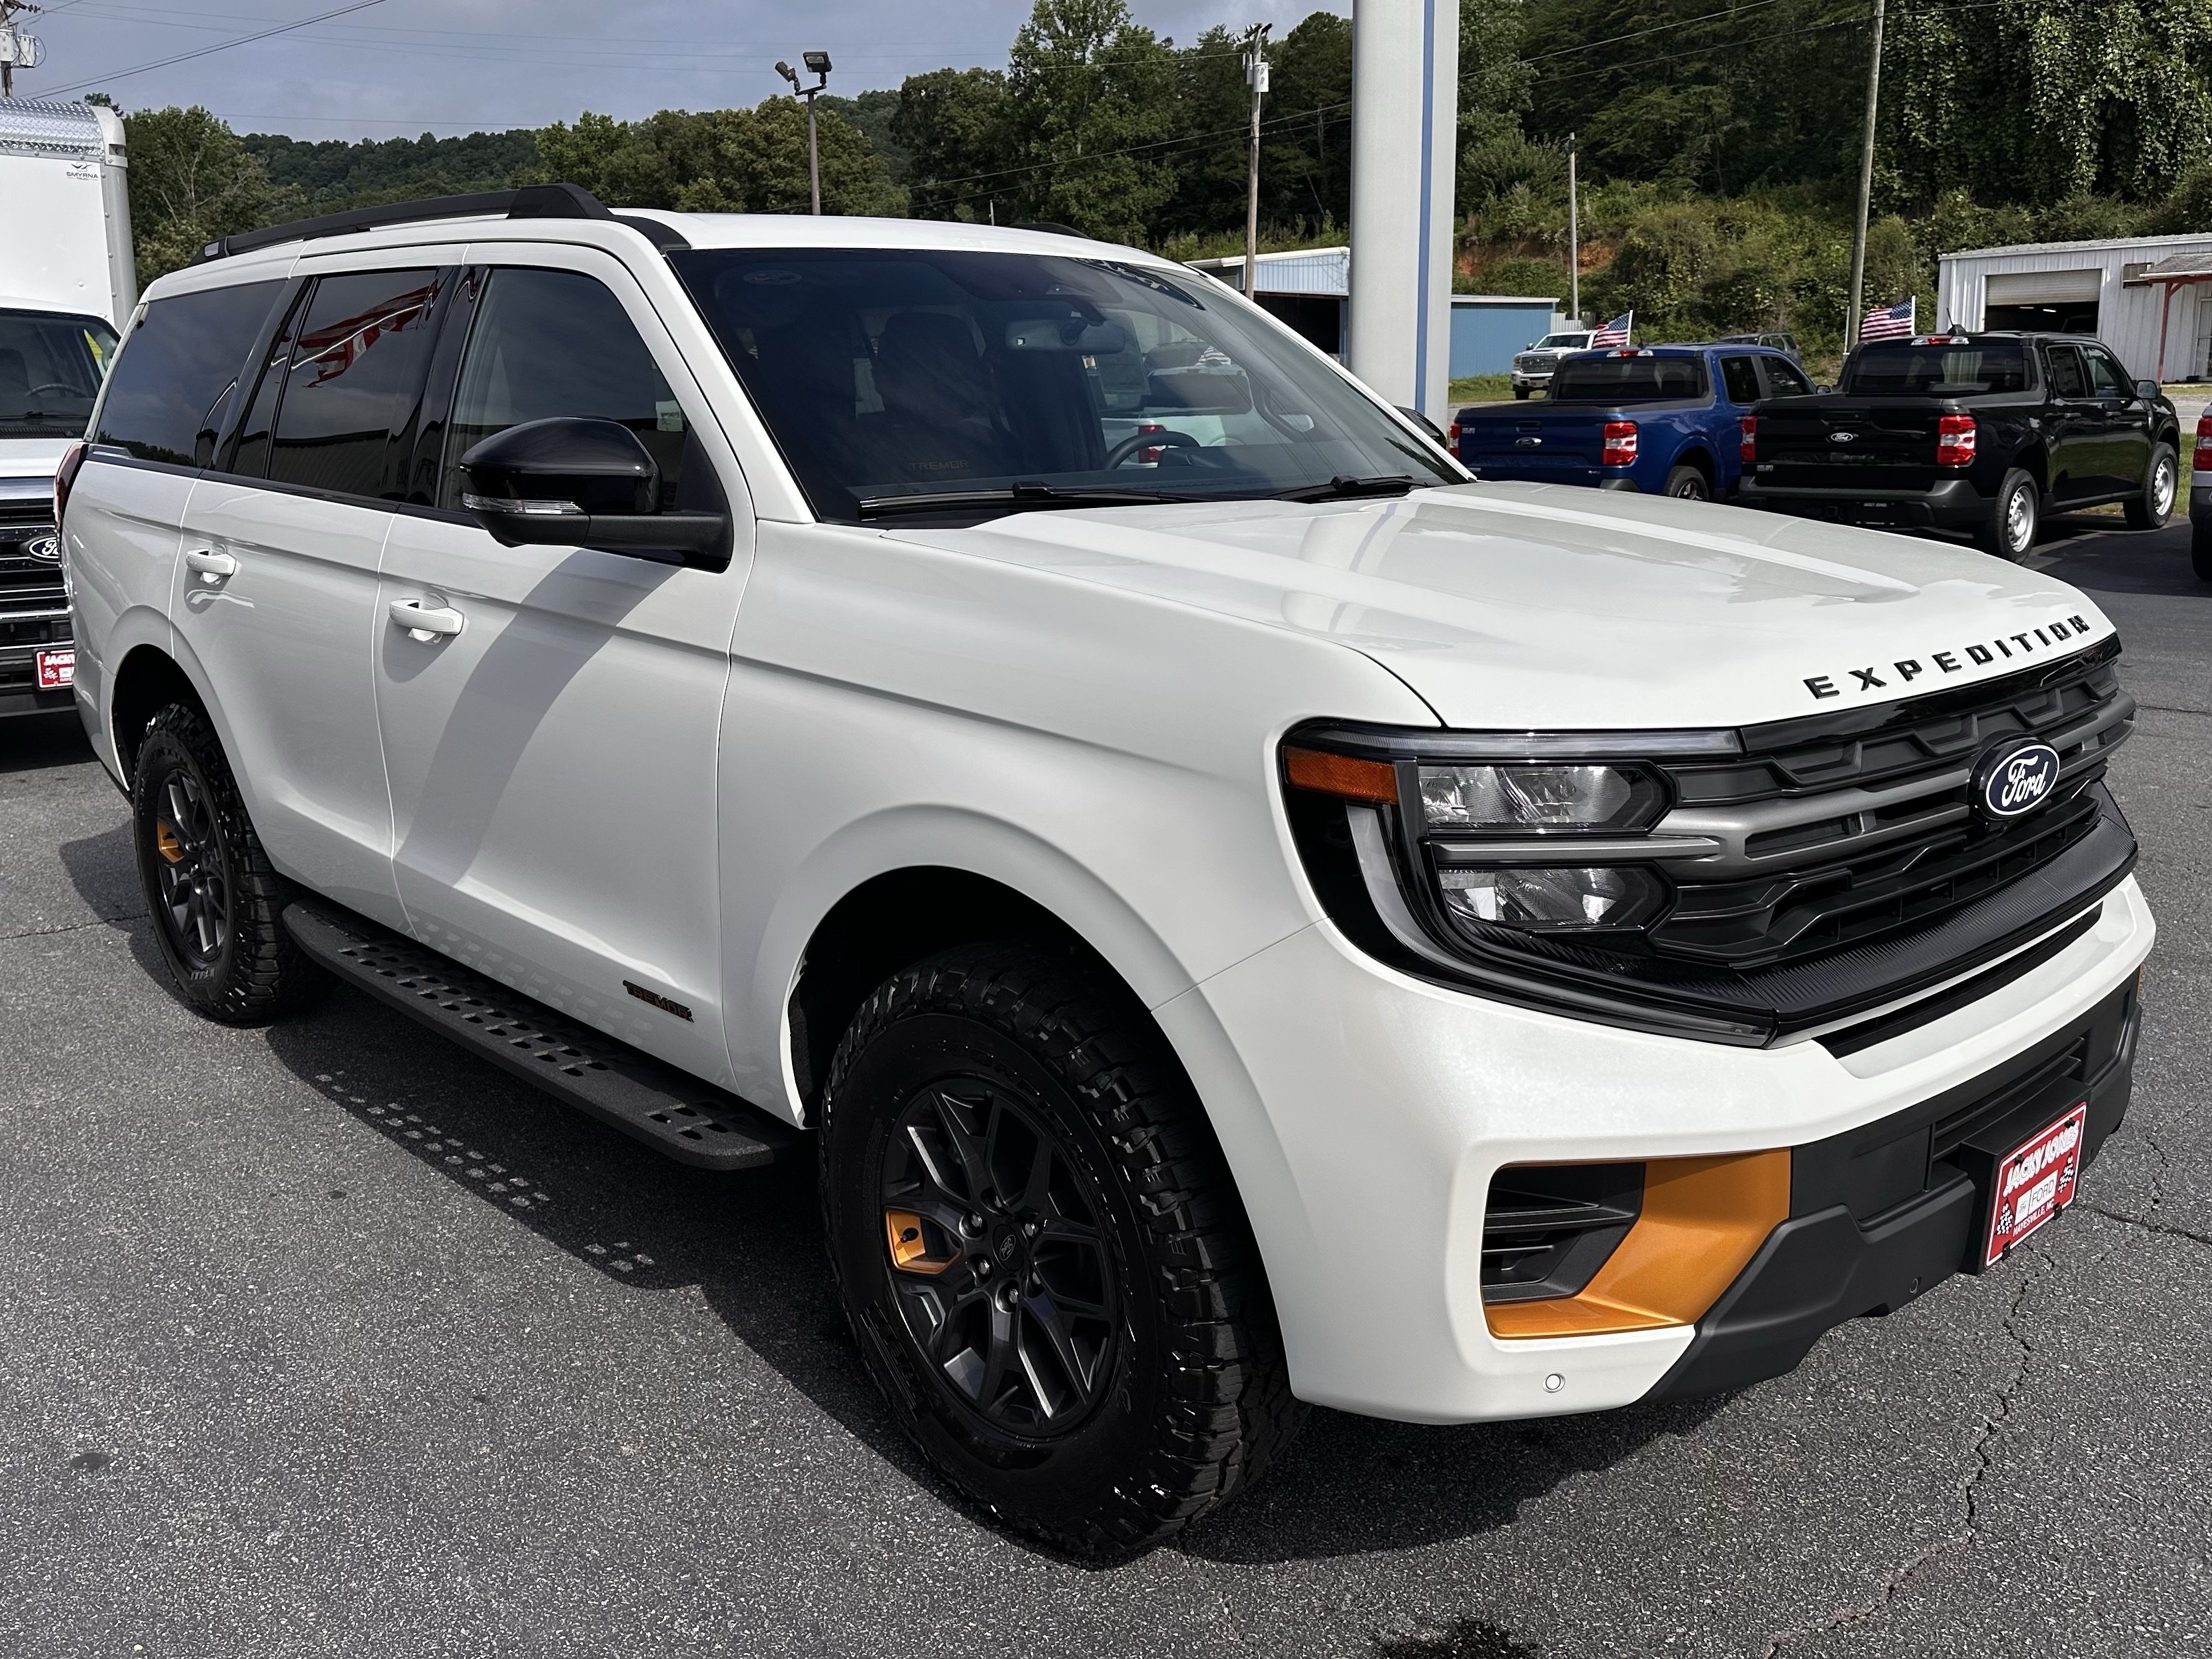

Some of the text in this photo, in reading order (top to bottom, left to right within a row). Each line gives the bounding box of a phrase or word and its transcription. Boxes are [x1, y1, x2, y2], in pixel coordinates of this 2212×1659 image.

[909, 460, 969, 471] TREMOR
[1803, 615, 2090, 699] EXPEDITION
[2001, 755, 2049, 807] Ford
[623, 980, 694, 1023] TREMOR
[2003, 1120, 2080, 1198] JACKY JONES
[2032, 1179, 2054, 1207] FORD
